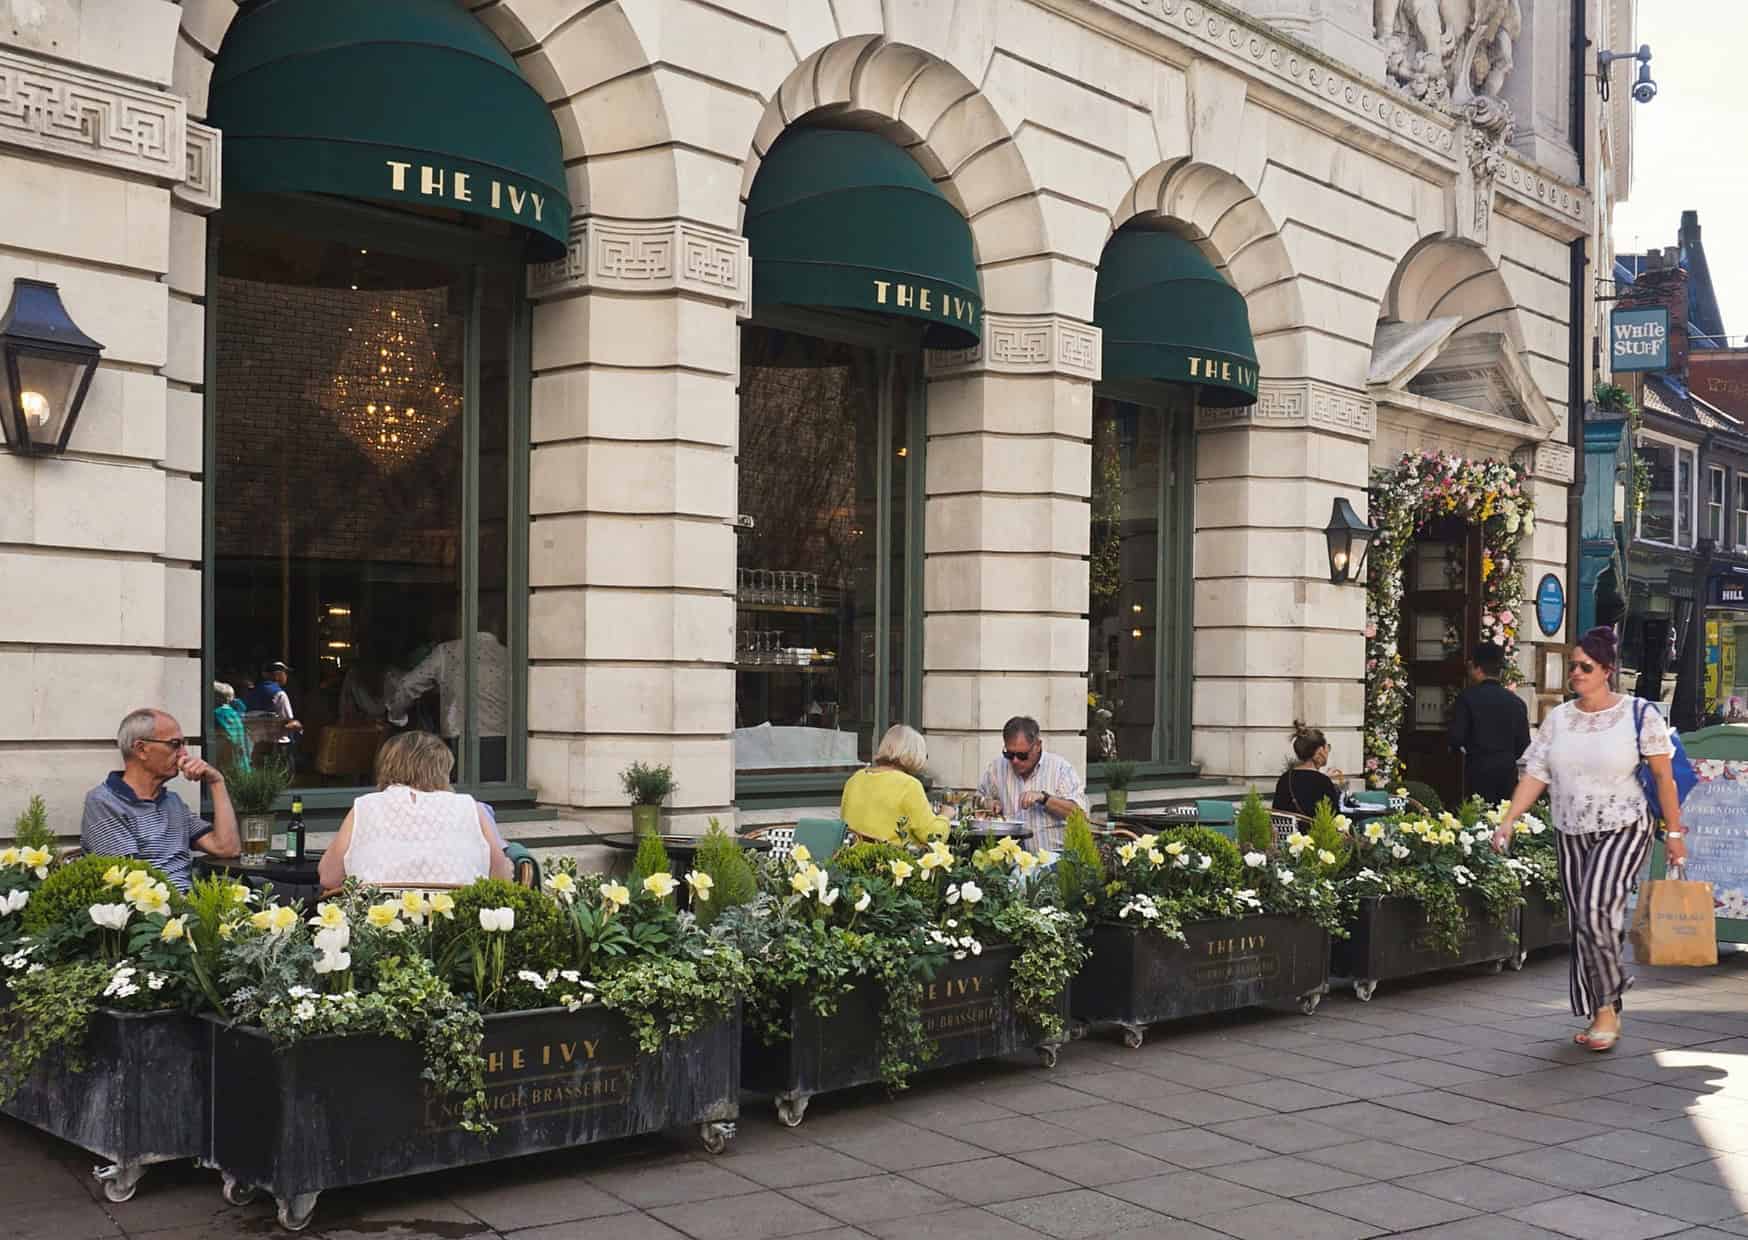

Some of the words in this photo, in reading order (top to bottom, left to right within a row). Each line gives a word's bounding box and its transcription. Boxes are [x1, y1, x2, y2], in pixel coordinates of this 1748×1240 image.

[386, 160, 472, 202] THE
[491, 180, 544, 222] IVY
[873, 280, 931, 312] THE
[943, 294, 974, 325] IVY
[1187, 356, 1231, 381] THE
[1238, 366, 1257, 390] IVY
[1722, 590, 1744, 601] HILL
[1241, 935, 1264, 951] IVY
[946, 976, 983, 998] IVY
[487, 1048, 526, 1073] HE
[541, 1039, 600, 1066] IVY
[532, 1078, 617, 1105] BRASSERIE
